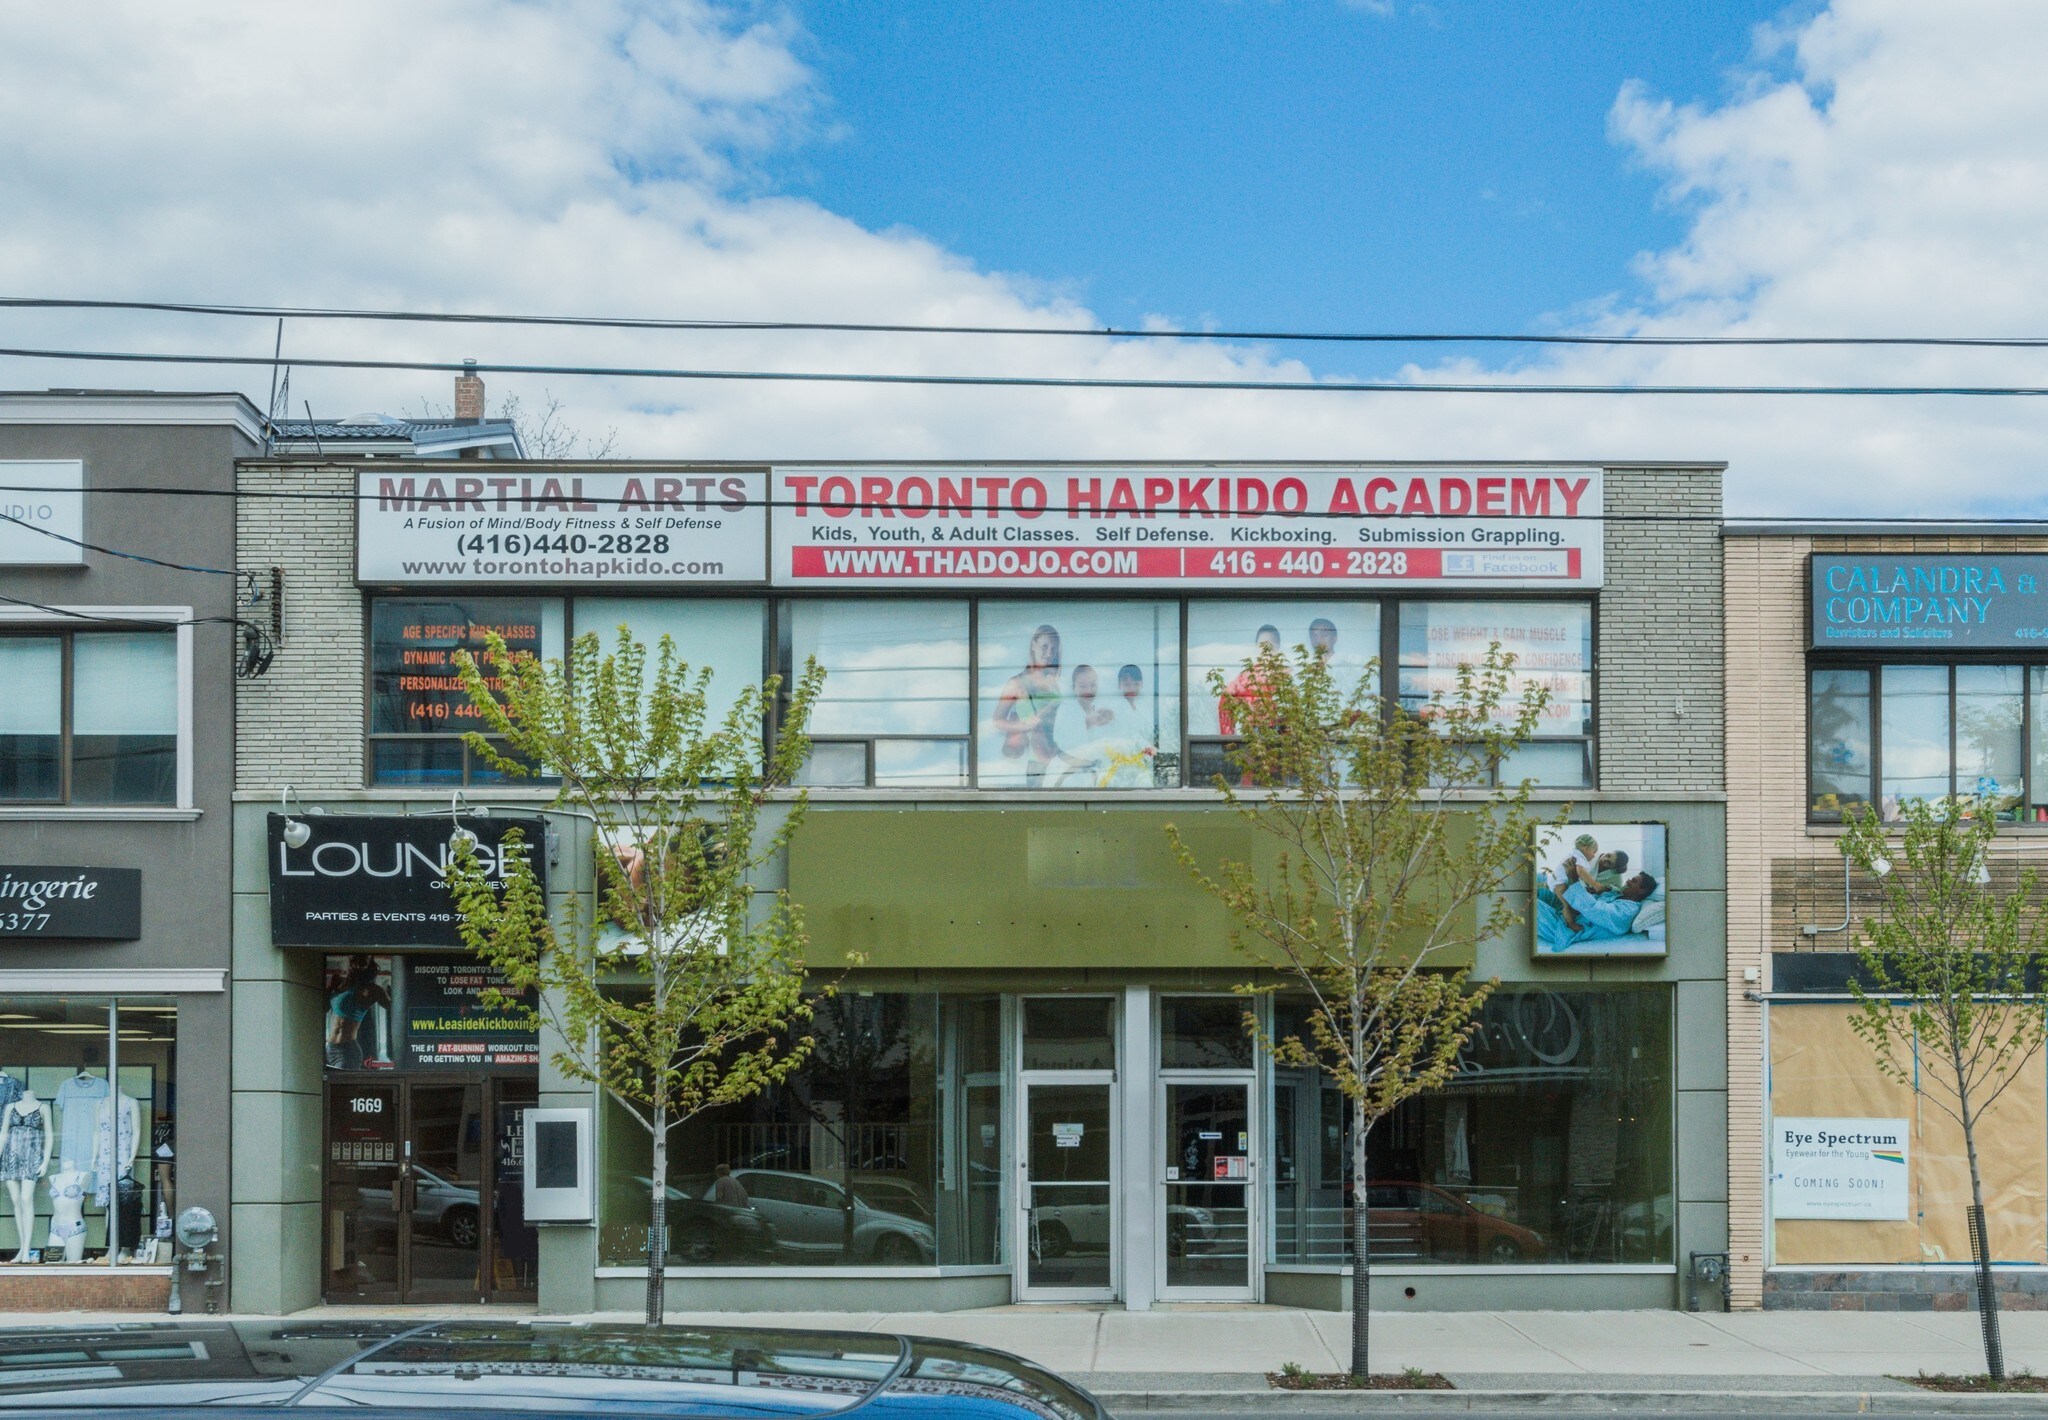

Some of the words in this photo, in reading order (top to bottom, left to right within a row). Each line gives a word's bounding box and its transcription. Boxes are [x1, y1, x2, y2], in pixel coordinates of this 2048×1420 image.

[378, 477, 598, 512] MARTIAL
[617, 477, 748, 513] ARTS
[785, 476, 1048, 519] TORONTO
[1066, 477, 1309, 520] HAPKIDO
[1327, 477, 1592, 521] ACADEMY
[403, 518, 415, 529] A
[417, 518, 465, 530] Fusion
[469, 517, 484, 530] of
[487, 517, 562, 532] Mind/Body
[565, 517, 617, 530] Fitness
[621, 518, 631, 530] &
[634, 517, 662, 530] Self
[665, 517, 722, 530] Defense
[811, 526, 858, 544] Kids,
[867, 526, 926, 544] Youth,
[931, 527, 945, 542] &
[949, 526, 998, 542] Adult
[1003, 526, 1080, 542] Classes.
[1095, 526, 1131, 542] Self
[1136, 526, 1215, 542] Defense.
[1230, 526, 1337, 545] Kickboxing.
[1358, 526, 1465, 543] Submission
[1470, 527, 1566, 546] Grappling.
[456, 533, 670, 557] (416)440-2828
[823, 549, 1138, 575] WWW.THADOJO.COM
[1483, 561, 1558, 573] Facebook
[1825, 565, 2007, 594] CALANDRA
[1826, 596, 1993, 624] COMPANY
[402, 625, 421, 640] AGE
[424, 625, 466, 640] SPECIFIC
[495, 625, 536, 640] CLASSES
[1426, 627, 1449, 641] LOSE
[1453, 627, 1488, 641] WEIGHT
[1503, 627, 1526, 641] GAIN
[1529, 627, 1566, 642] MUSCLE
[1826, 626, 1878, 639] Barristers
[1879, 627, 1900, 638] and
[1902, 626, 1953, 639] Solicitors
[403, 651, 446, 665] DYNAMIC
[1525, 652, 1583, 667] CONFIDENCE
[410, 702, 450, 720] (416)
[280, 841, 535, 878] LOUNGE
[429, 880, 451, 889] ON
[305, 912, 358, 922] PARTIES
[361, 912, 370, 921] &
[373, 913, 426, 922] EVENTS
[414, 965, 450, 974] DISCOVER
[452, 965, 492, 974] TORONTO'S
[437, 976, 447, 985] TO
[450, 976, 469, 985] LOSE
[469, 976, 483, 985] FAT
[486, 976, 505, 985] TONE
[443, 987, 463, 996] LOOK
[466, 987, 481, 996] AND
[501, 987, 525, 996] GREAT
[410, 1043, 426, 1053] THE
[426, 1043, 435, 1053] #1
[438, 1043, 485, 1053] FAT-BURNING
[487, 1043, 523, 1053] WORKOUT
[418, 1054, 434, 1064] FOR
[434, 1054, 465, 1064] GETTING
[466, 1054, 482, 1064] YOU
[484, 1054, 492, 1064] IN
[495, 1054, 527, 1064] AMAZING
[350, 1097, 382, 1113] 1669
[1784, 1130, 1813, 1147] Eye
[1817, 1131, 1898, 1148] Spectrum
[1785, 1148, 1818, 1158] Eyewear
[1818, 1149, 1830, 1157] for
[1831, 1149, 1844, 1158] the
[1845, 1149, 1870, 1160] Young
[1794, 1176, 1840, 1188] COMING
